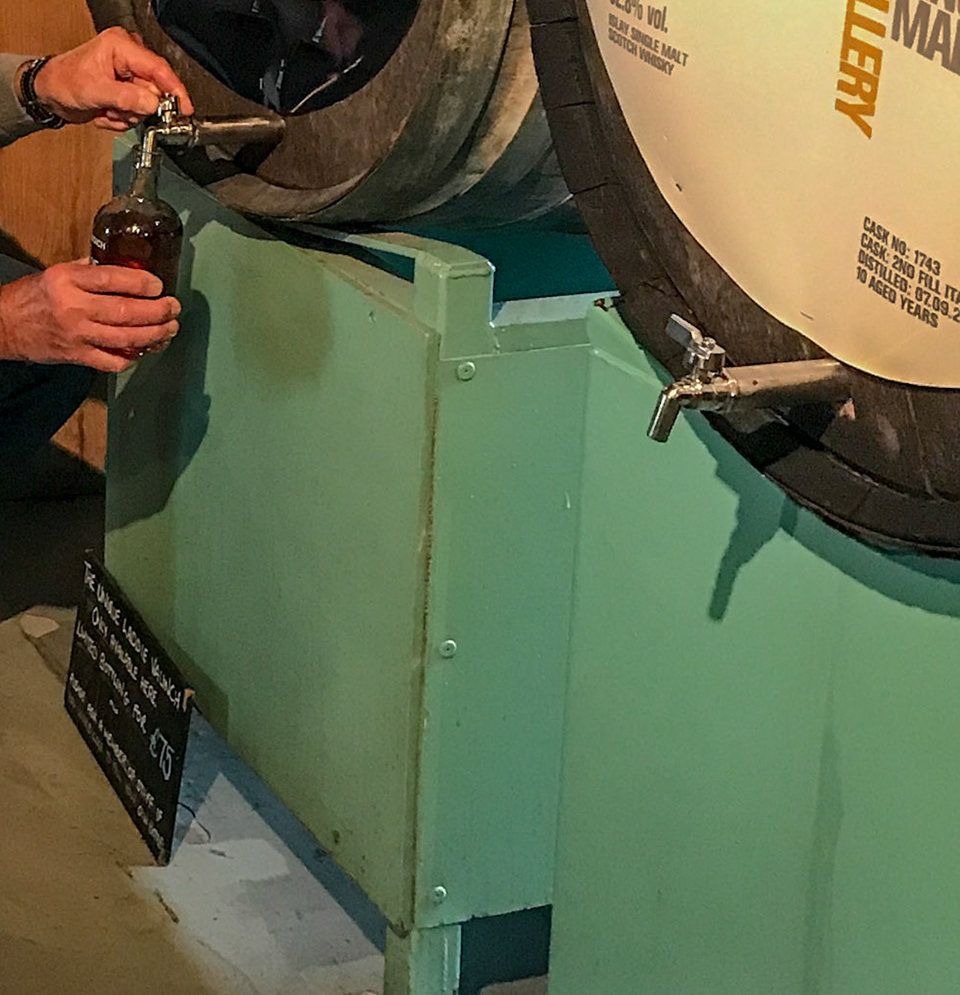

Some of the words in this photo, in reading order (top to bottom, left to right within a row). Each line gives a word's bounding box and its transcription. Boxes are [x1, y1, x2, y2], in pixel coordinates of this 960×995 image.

[608, 28, 638, 56] SCOTCH
[639, 47, 674, 76] WHISKY
[609, 13, 629, 36] ISLAY
[631, 27, 659, 53] SINGLE
[661, 43, 689, 67] MALT
[858, 248, 912, 296] DISTILLED:
[861, 233, 889, 264] CASK:
[892, 254, 915, 280] 2ND
[918, 270, 941, 295] FILL
[863, 216, 889, 245] CASK
[914, 250, 941, 276] 1743
[856, 266, 867, 284] 10
[868, 276, 896, 304] AGED
[900, 294, 938, 328] YEARS
